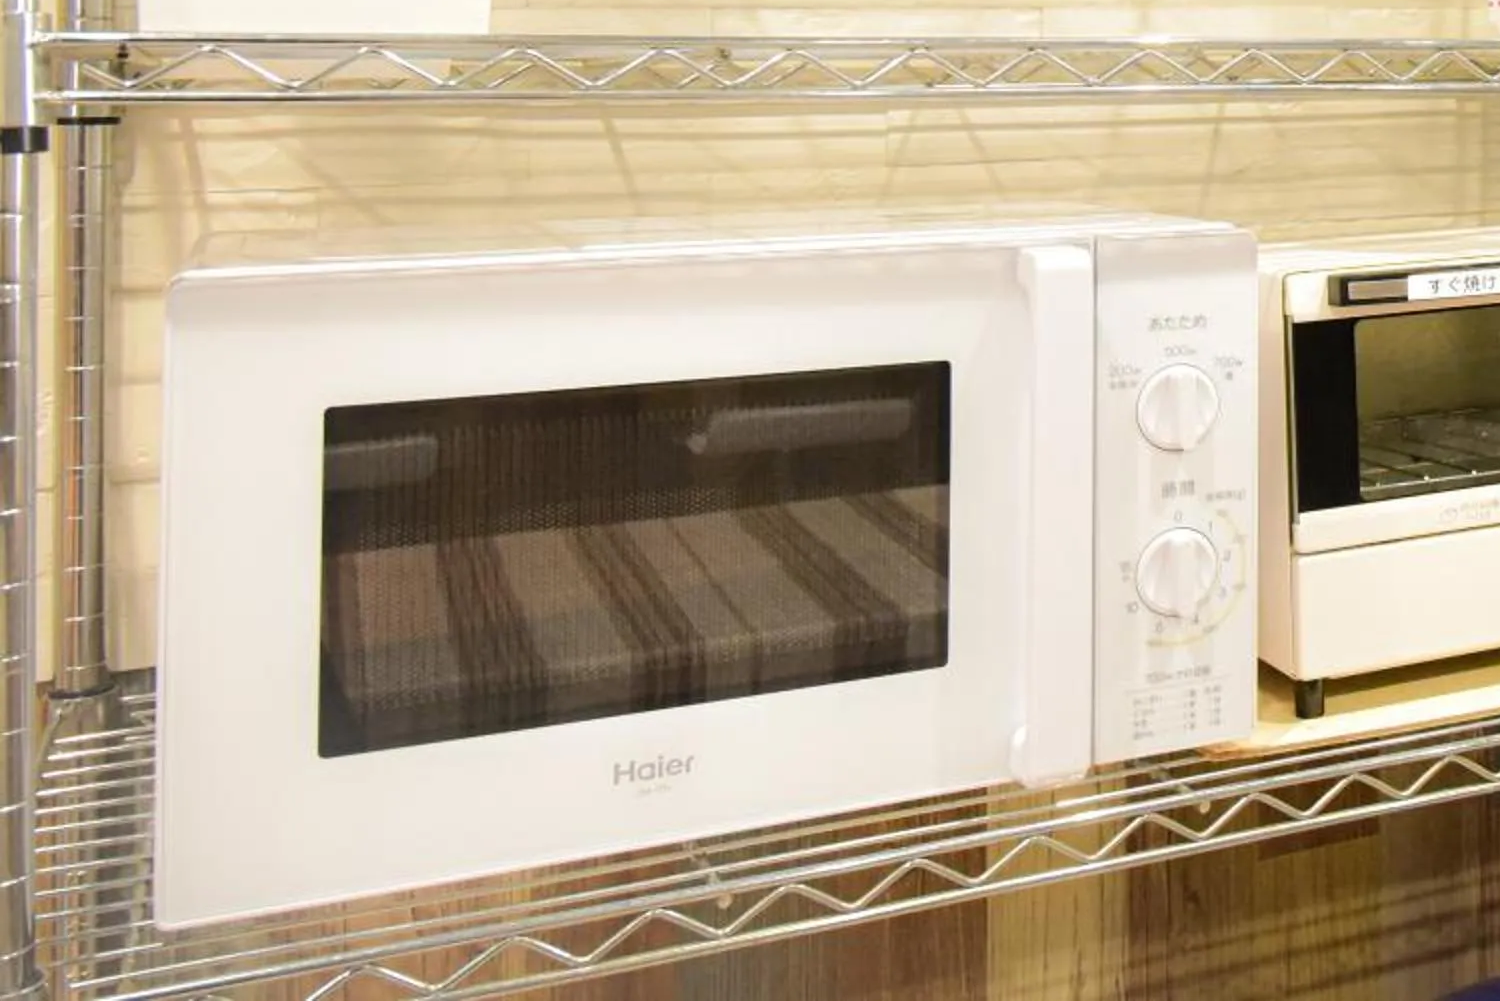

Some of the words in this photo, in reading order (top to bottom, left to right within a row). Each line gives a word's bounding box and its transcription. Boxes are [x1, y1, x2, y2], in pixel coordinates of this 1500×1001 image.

[1147, 313, 1208, 332] あたため
[613, 755, 695, 786] Haier
